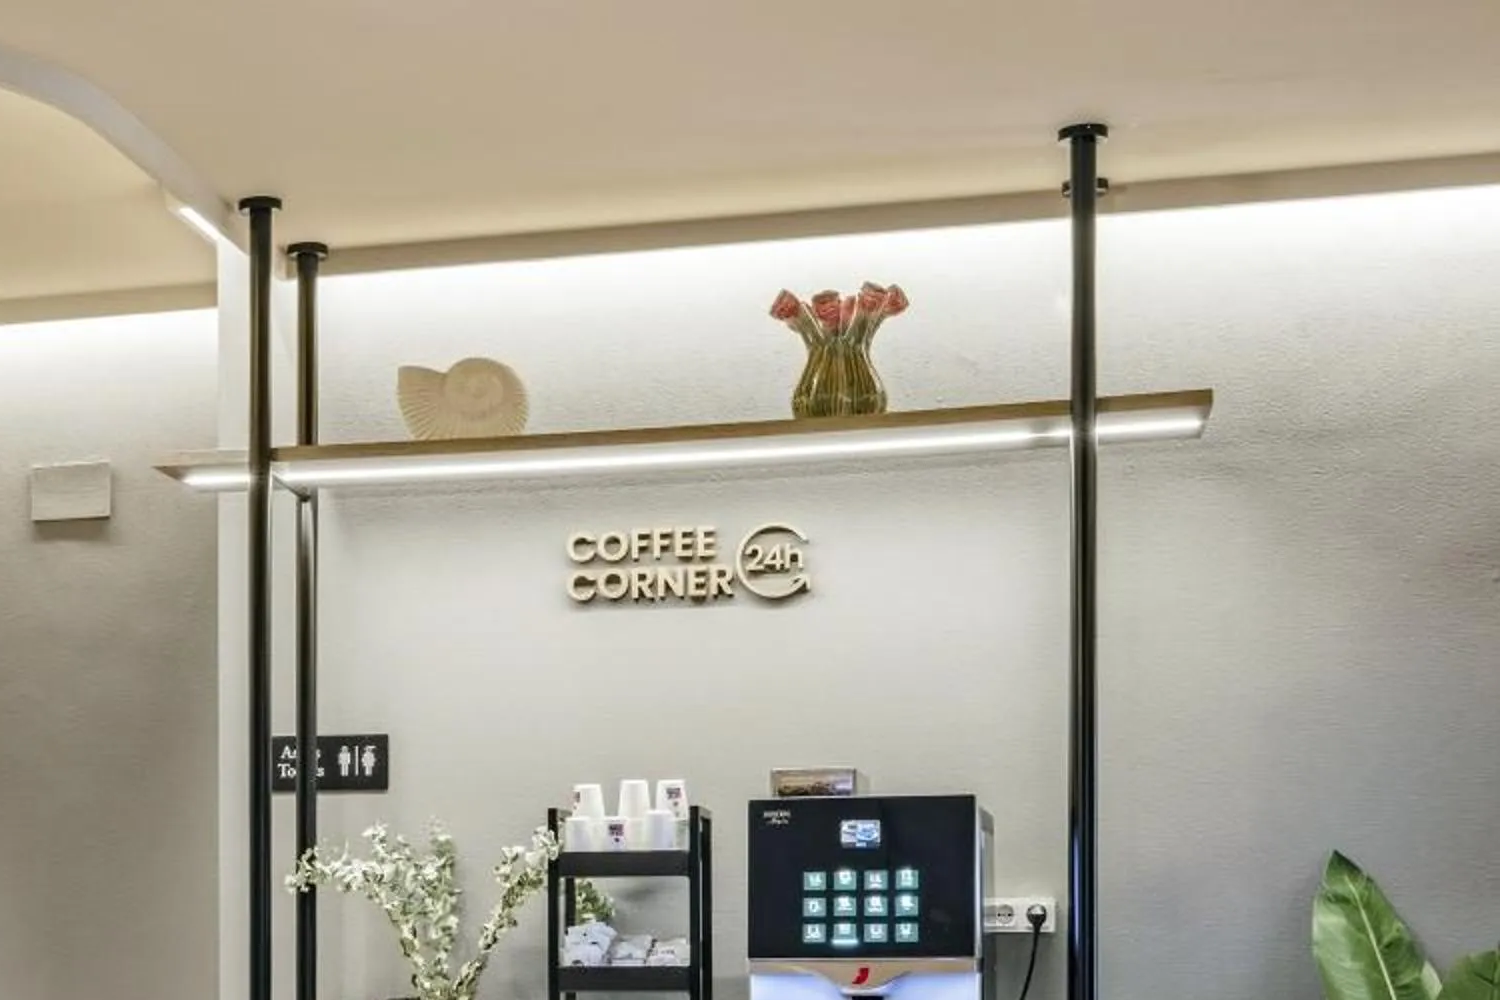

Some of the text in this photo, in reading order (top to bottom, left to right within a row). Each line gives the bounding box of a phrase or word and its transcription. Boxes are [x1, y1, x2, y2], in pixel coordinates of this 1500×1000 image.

[567, 526, 717, 563] COFFEE
[744, 543, 804, 572] 24h
[567, 564, 735, 601] CORNER
